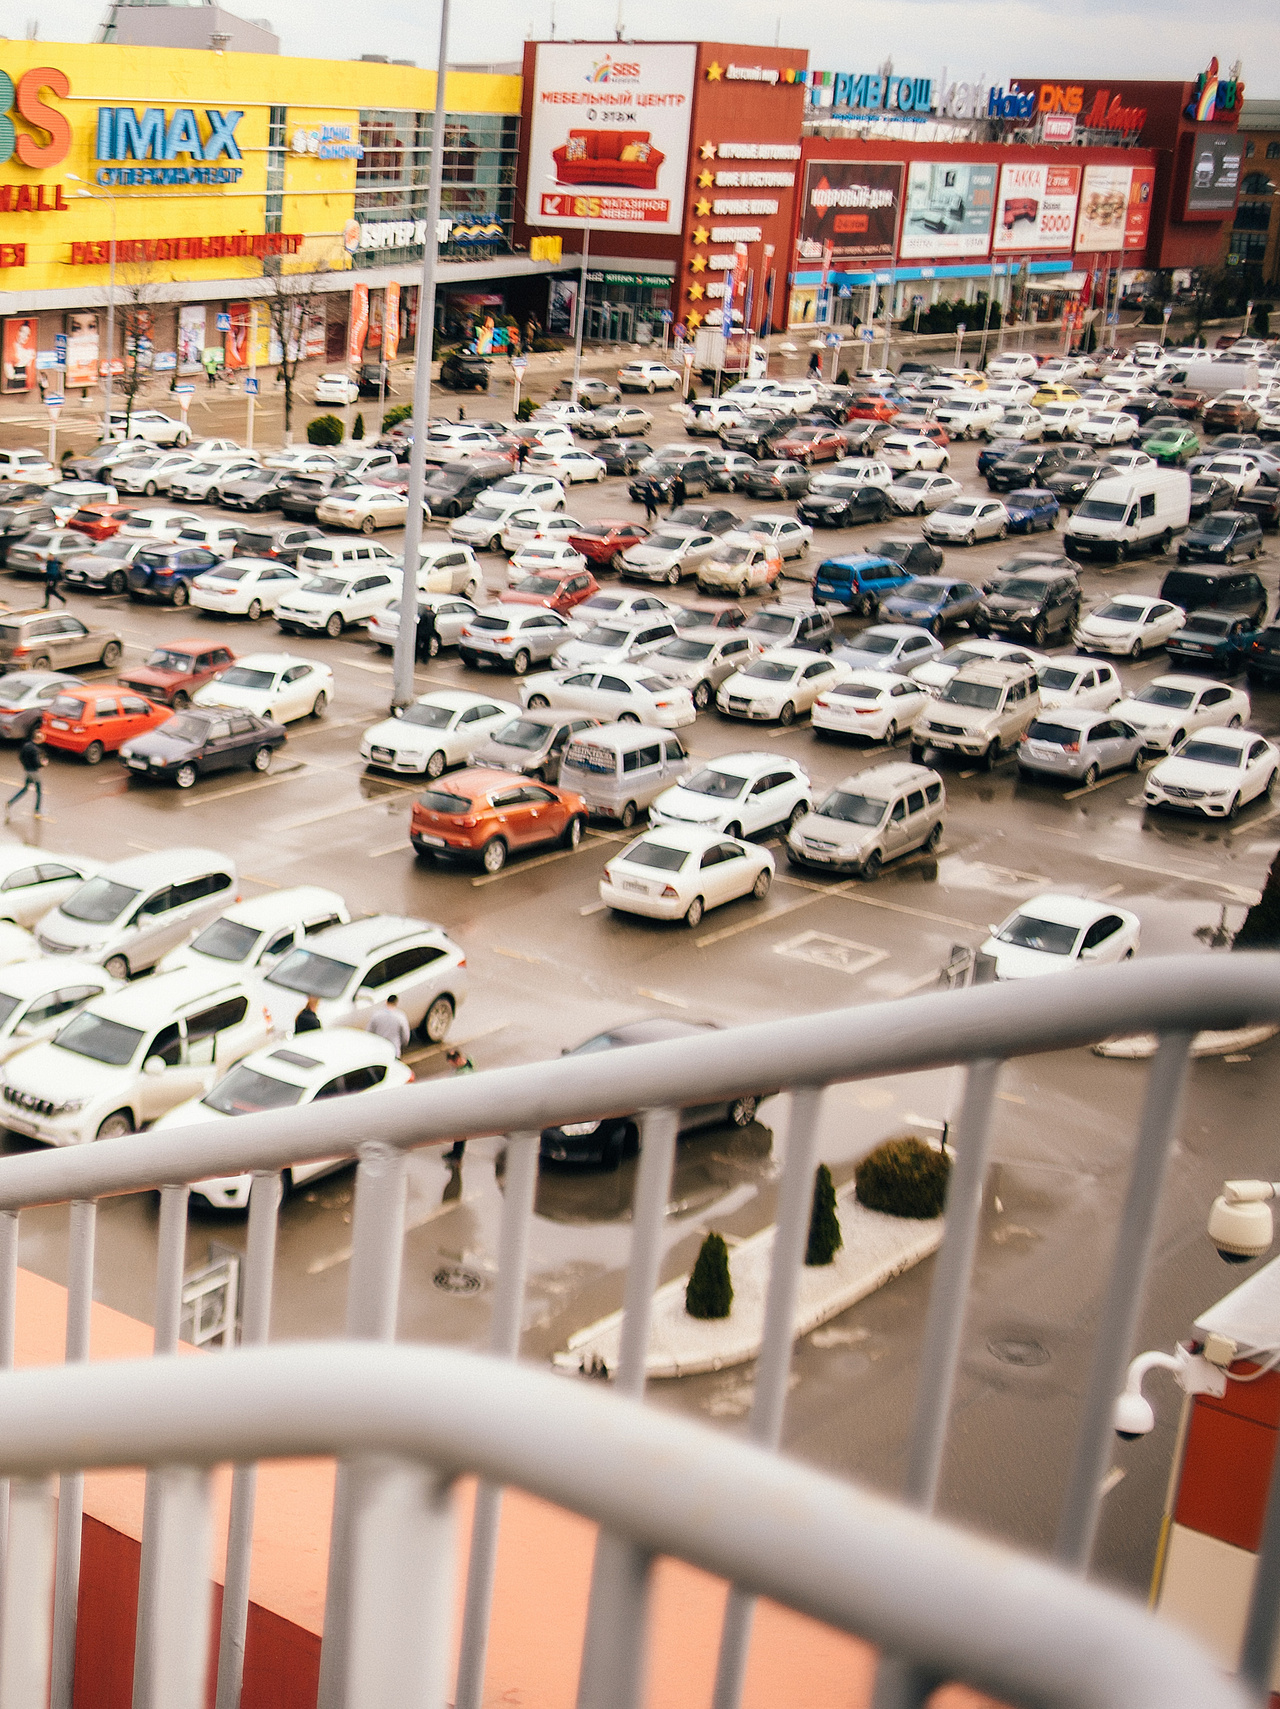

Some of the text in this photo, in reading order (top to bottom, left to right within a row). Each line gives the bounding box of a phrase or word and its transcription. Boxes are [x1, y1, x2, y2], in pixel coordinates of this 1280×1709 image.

[612, 63, 641, 77] SBS
[541, 90, 686, 109] МЕБЕЛЬНЫЙ ЦЕНТР
[833, 72, 931, 113] РИВ ГОШ
[1038, 84, 1084, 114] DNS
[97, 106, 245, 161] IMAX
[573, 197, 602, 217] 85
[414, 218, 453, 246] КНГ
[252, 232, 304, 261] ЦЕНТР
